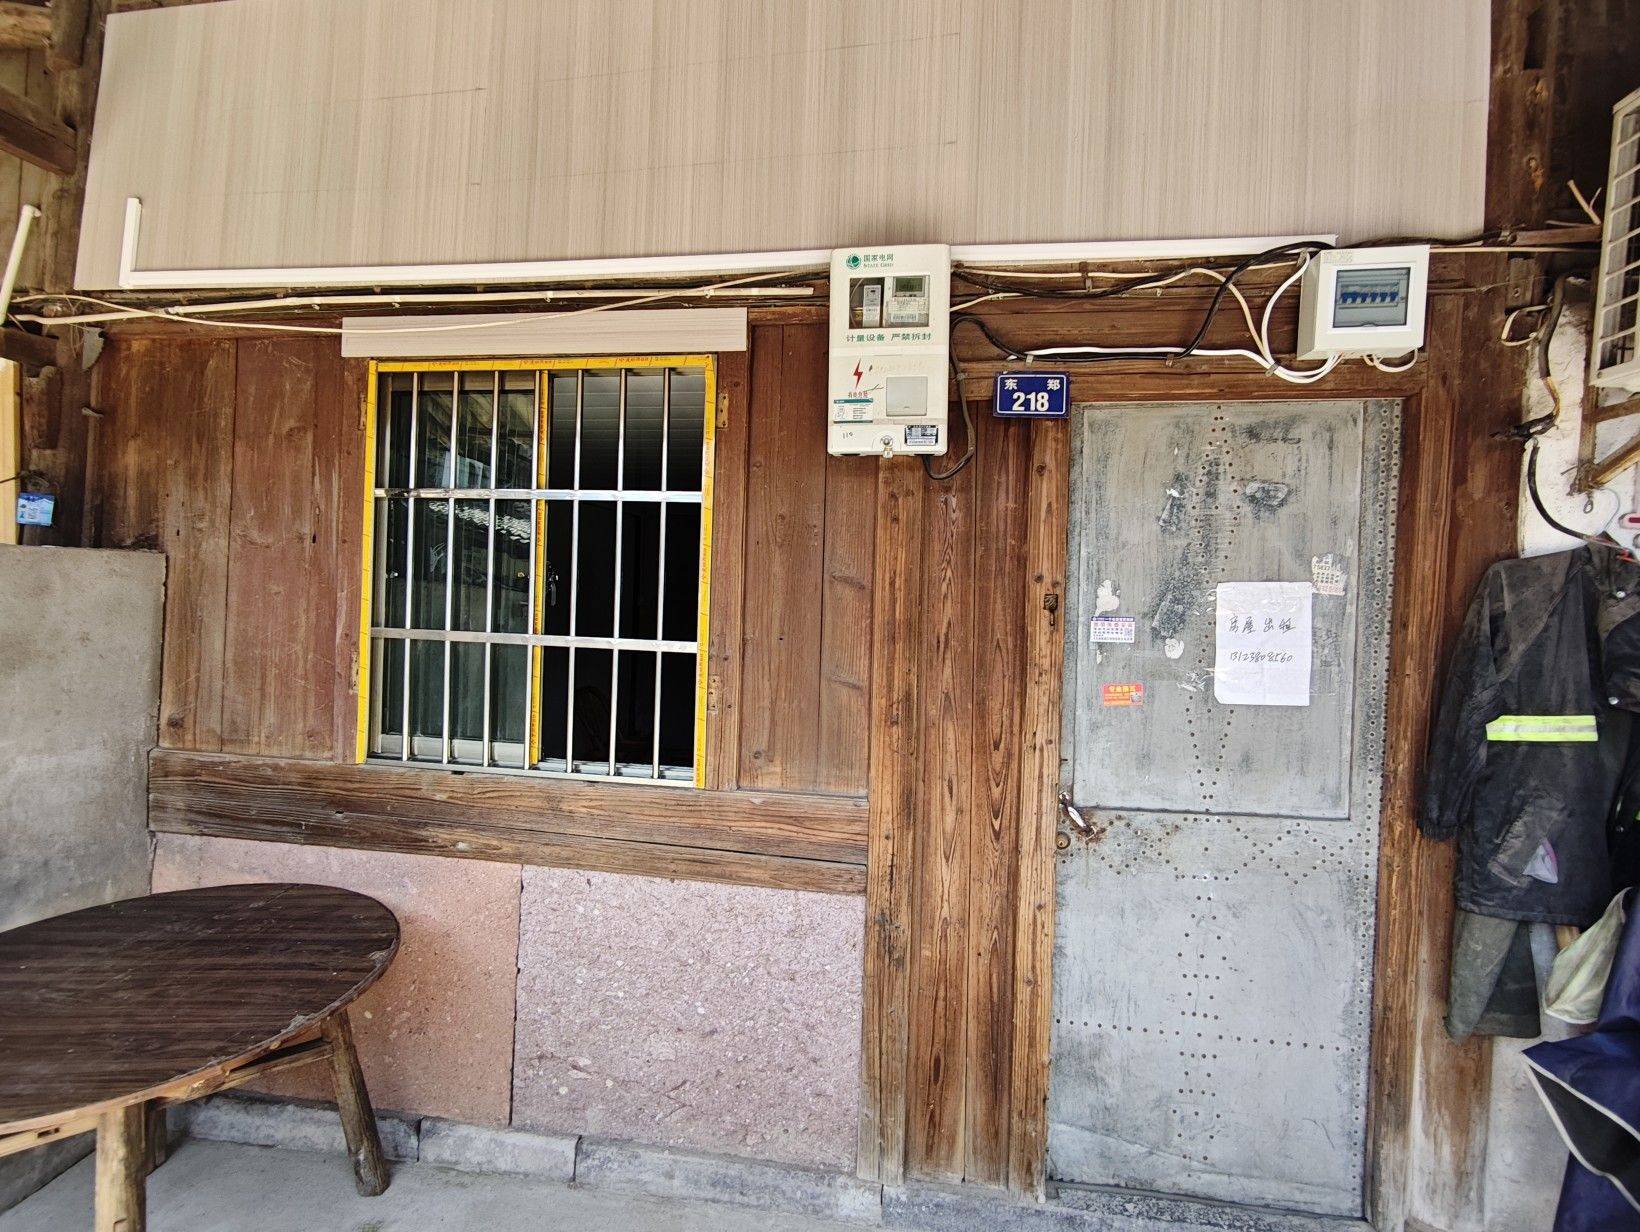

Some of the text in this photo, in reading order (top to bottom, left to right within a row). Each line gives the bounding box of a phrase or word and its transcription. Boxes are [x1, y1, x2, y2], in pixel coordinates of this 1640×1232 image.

[864, 254, 894, 262] 国家电网
[846, 332, 932, 342] 计量设备 严禁拆封
[1012, 391, 1050, 412] 218
